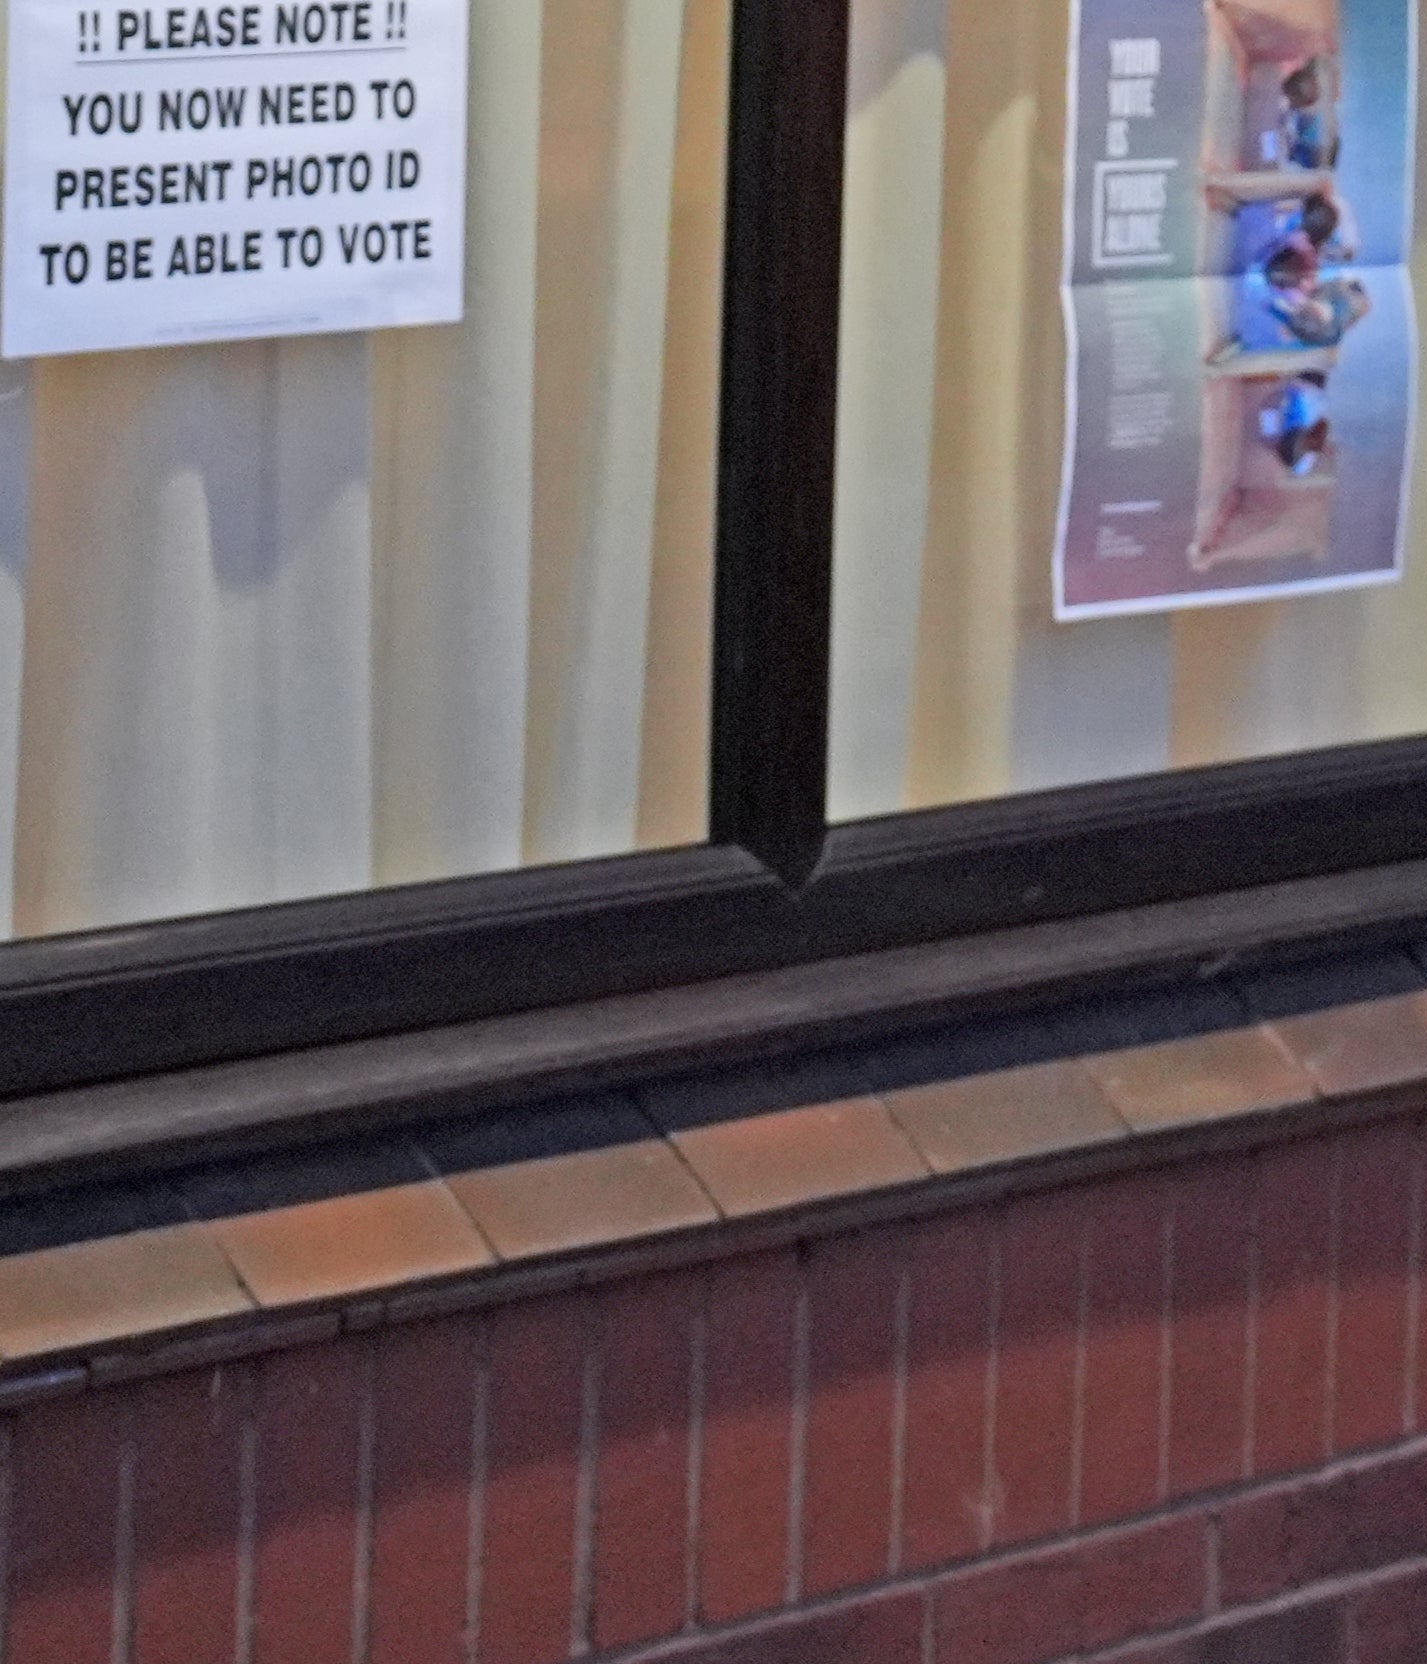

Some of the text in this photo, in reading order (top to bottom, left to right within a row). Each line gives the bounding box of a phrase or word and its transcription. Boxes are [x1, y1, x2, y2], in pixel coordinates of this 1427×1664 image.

[78, 10, 101, 53] !!
[116, 5, 262, 53] PLEASE
[275, 0, 373, 46] NOTE
[62, 77, 417, 137] YOU NOW NEED TO
[55, 149, 421, 211] PRESENT PHOTO ID
[40, 218, 433, 286] TO BE ABLE TO VOTE
